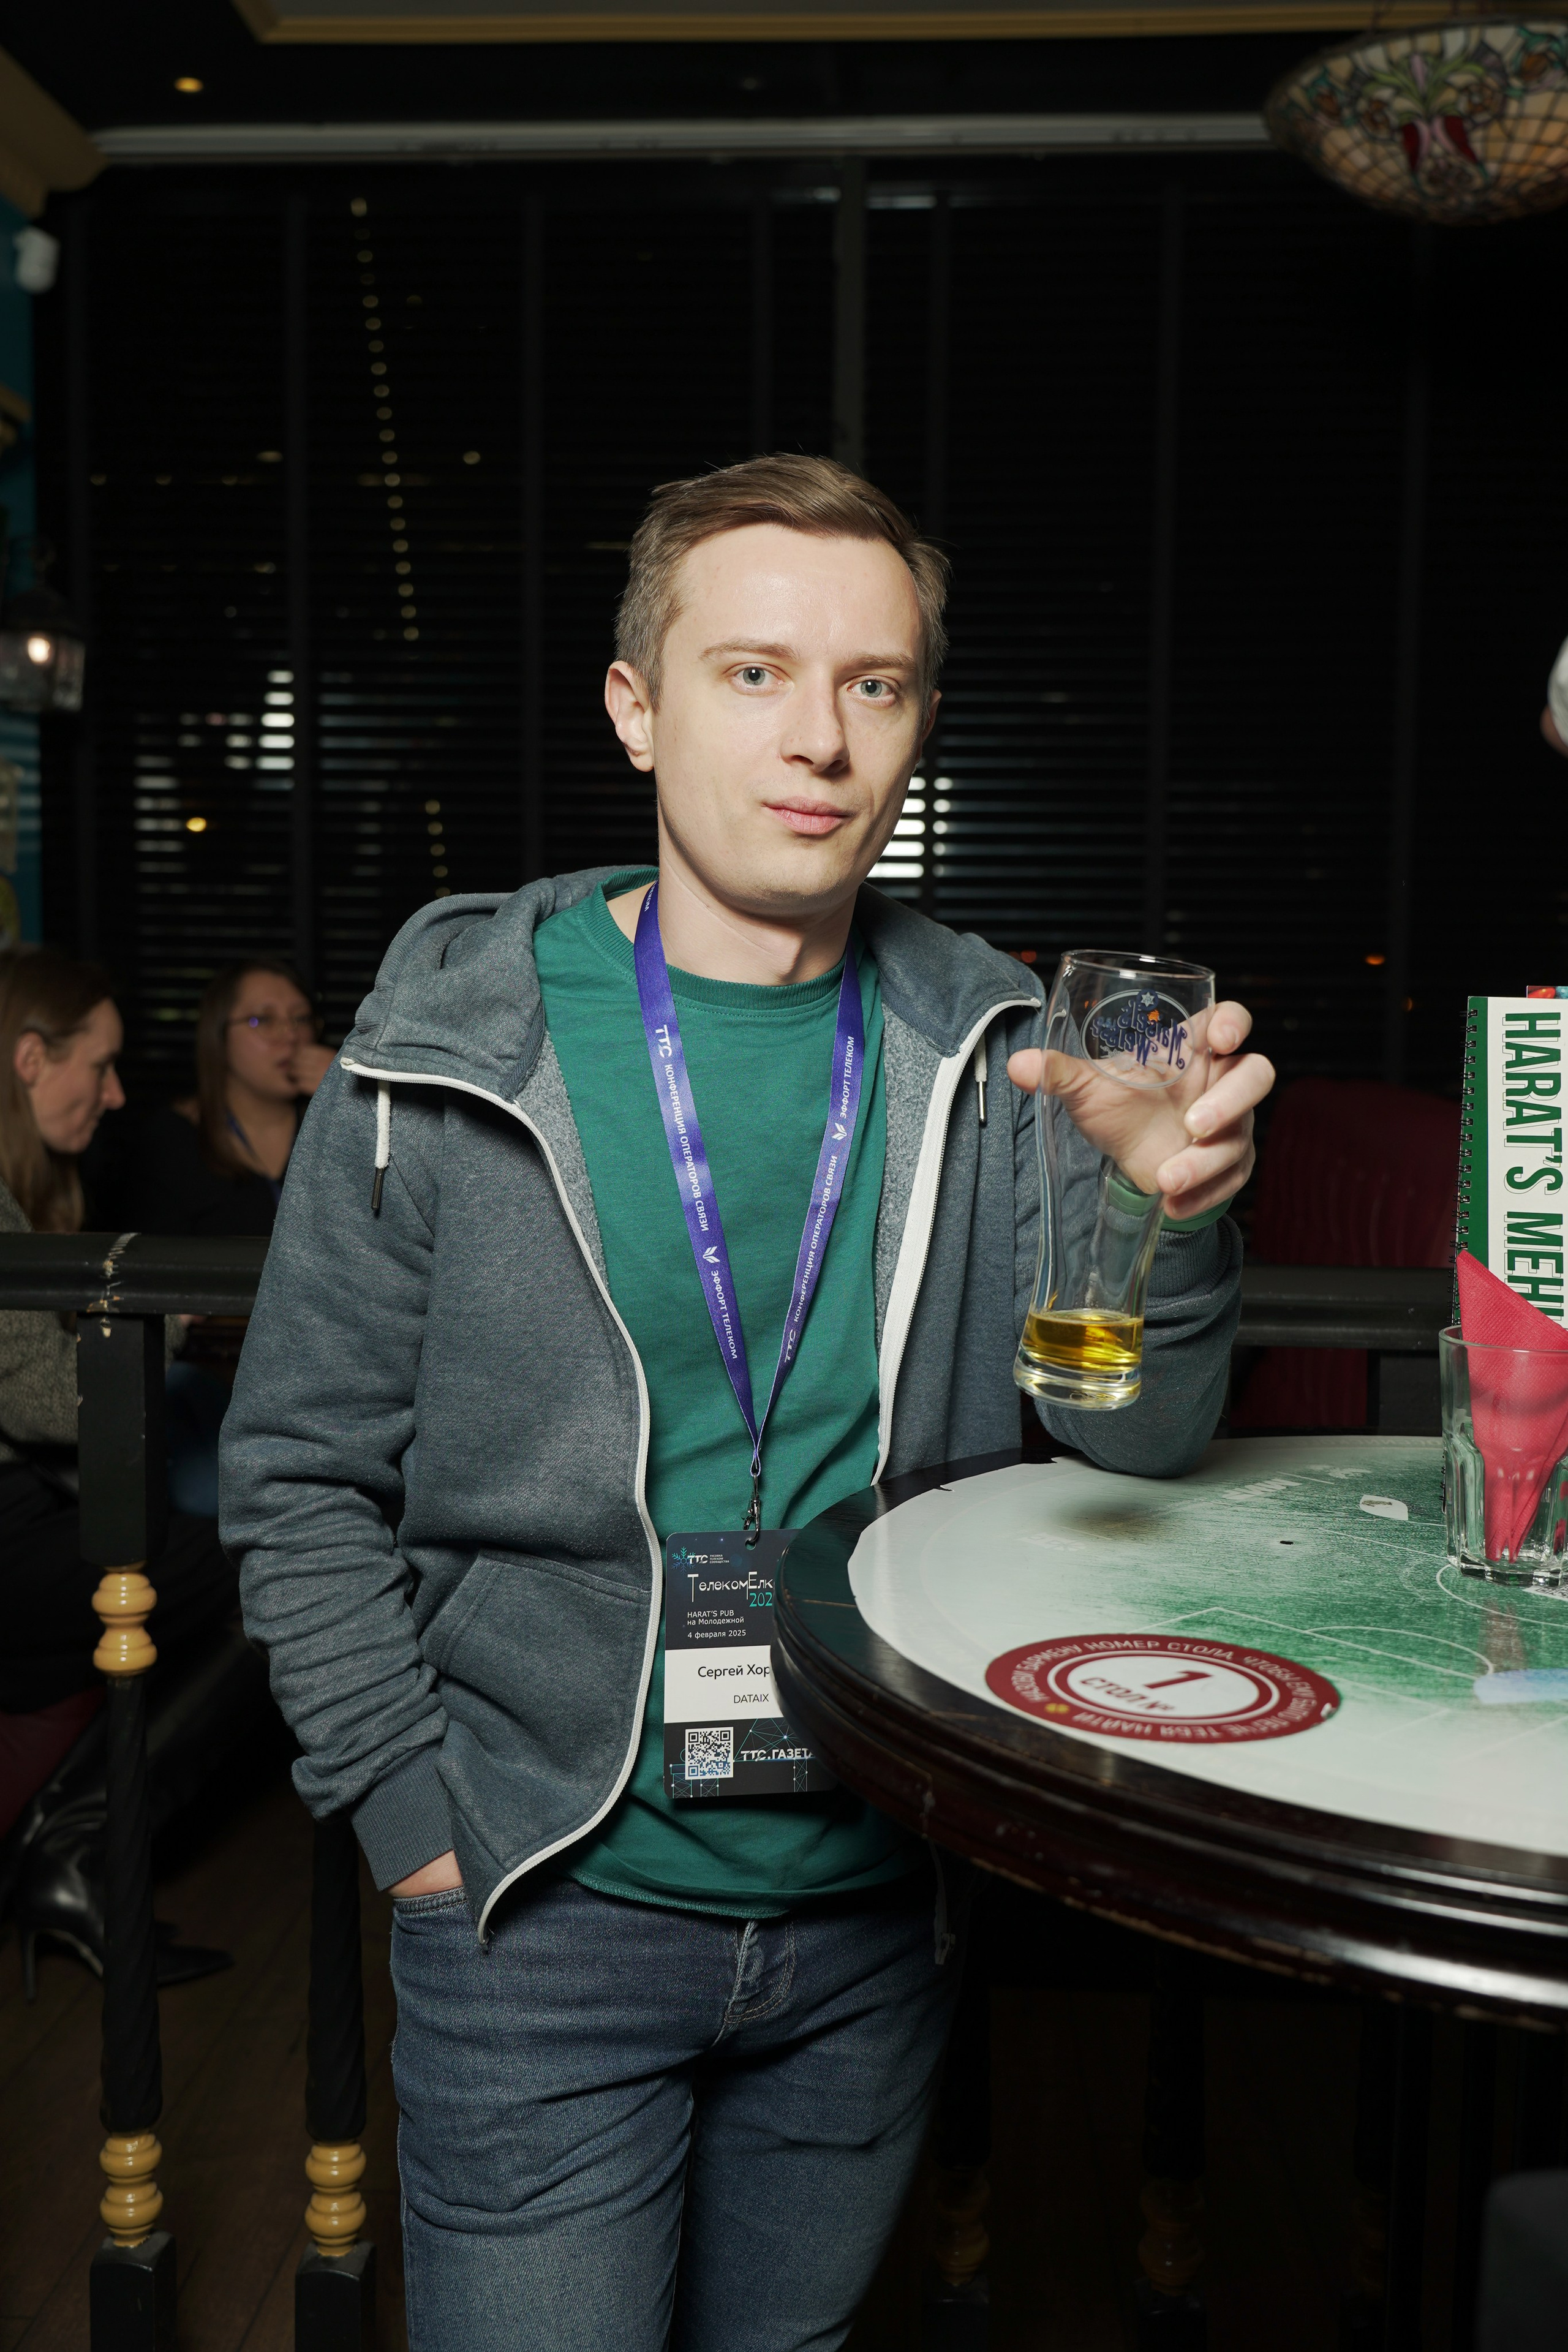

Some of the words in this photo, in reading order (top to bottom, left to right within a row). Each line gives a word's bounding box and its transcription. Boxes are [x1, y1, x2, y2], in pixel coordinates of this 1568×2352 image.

[843, 1036, 854, 1078] ТЕЛЕКОМ
[840, 1079, 851, 1119] ЭФФОРТ
[1504, 1012, 1564, 1194] HARAT'S
[655, 1024, 673, 1058] ТТС
[665, 1064, 687, 1134] КОНФЕРЕНЦИЯ
[680, 1136, 701, 1199] ОПЕРАТОРОВ
[695, 1200, 709, 1232] СВЯЗИ
[784, 1329, 796, 1363] ТТС
[794, 1251, 815, 1323] КОНФЕРЕНЦИЯ
[810, 1187, 831, 1250] ОПЕРАТОРОВ
[826, 1155, 838, 1186] СВЯЗИ
[1504, 1212, 1564, 1321] МЕН
[711, 1270, 727, 1311] ЭФФОРТ
[722, 1313, 737, 1359] ТЕЛЕКОМ
[687, 1555, 709, 1564] ТТС
[687, 1571, 773, 1602] ТелекомЕлк
[749, 1592, 772, 1607] 202
[698, 1616, 744, 1625] Молодежной
[695, 1630, 726, 1640] февраля
[1084, 1640, 1160, 1651] НОМЕР
[698, 1665, 744, 1679] Сергей
[747, 1664, 771, 1677] Хор
[1143, 1670, 1213, 1689] 1
[1243, 1656, 1302, 1681] ЧТОБЫ
[733, 1694, 769, 1703] DATAIX
[1079, 1676, 1148, 1703] СТОЛ
[1072, 1711, 1153, 1735] НАЙТИ
[1160, 1725, 1223, 1738] ТЕБЯ
